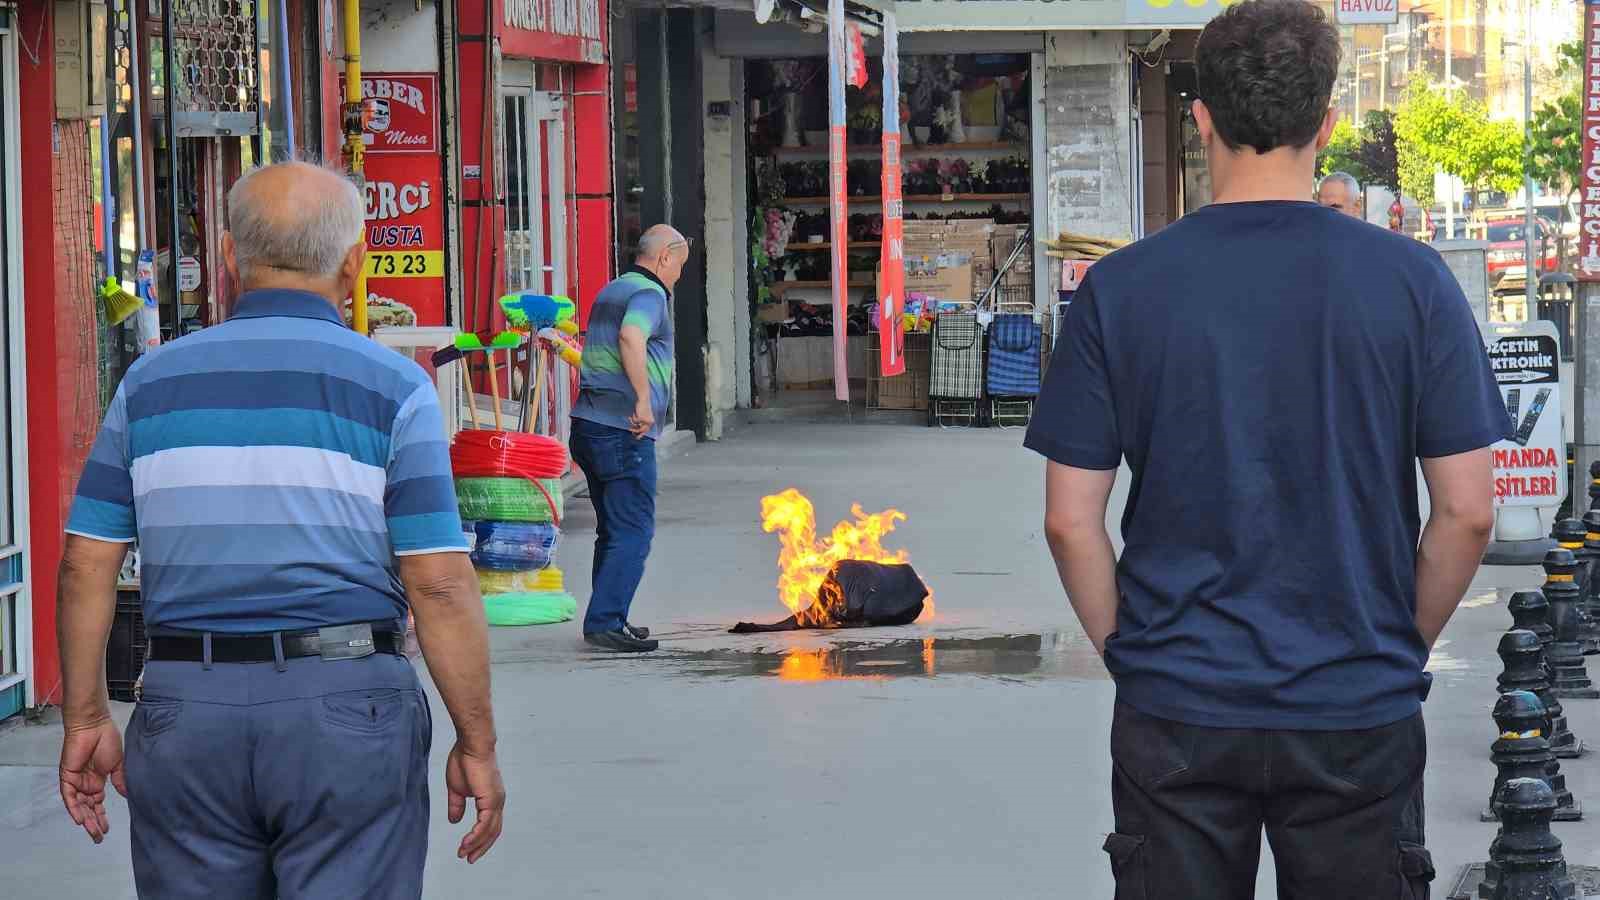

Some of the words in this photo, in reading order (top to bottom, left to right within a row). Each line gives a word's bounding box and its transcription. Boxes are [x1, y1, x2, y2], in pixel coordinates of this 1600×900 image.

[340, 79, 426, 115] RBER
[384, 130, 428, 145] Musa
[370, 224, 424, 247] USTA
[371, 254, 395, 275] 73
[402, 254, 426, 275] 23
[1489, 352, 1553, 370] KTRONİK
[1492, 447, 1559, 469] MANDA
[1494, 470, 1558, 505] ŞİTLERİ
